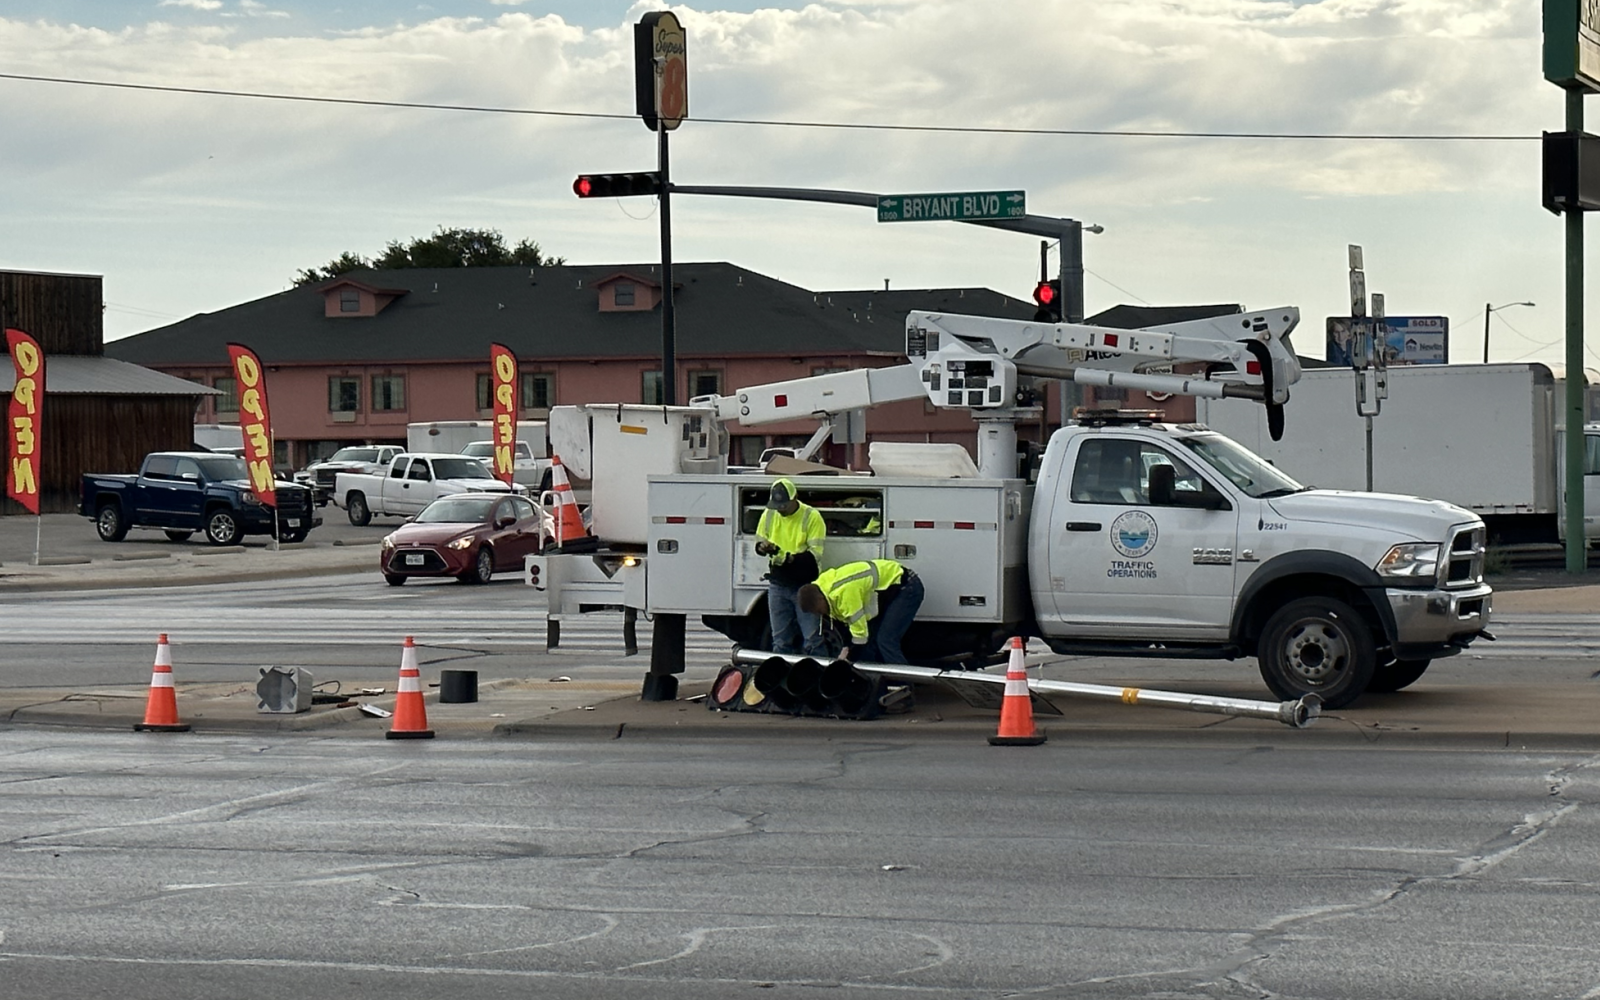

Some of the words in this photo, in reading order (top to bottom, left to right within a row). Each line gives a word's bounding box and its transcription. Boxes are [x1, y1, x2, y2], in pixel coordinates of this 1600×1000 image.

[655, 28, 684, 58] Super
[662, 57, 683, 118] 8
[903, 197, 959, 218] BRYANT
[963, 195, 1000, 216] BLVD
[1107, 569, 1157, 579] OPERATIONS
[1111, 560, 1154, 570] TRAFFIC
